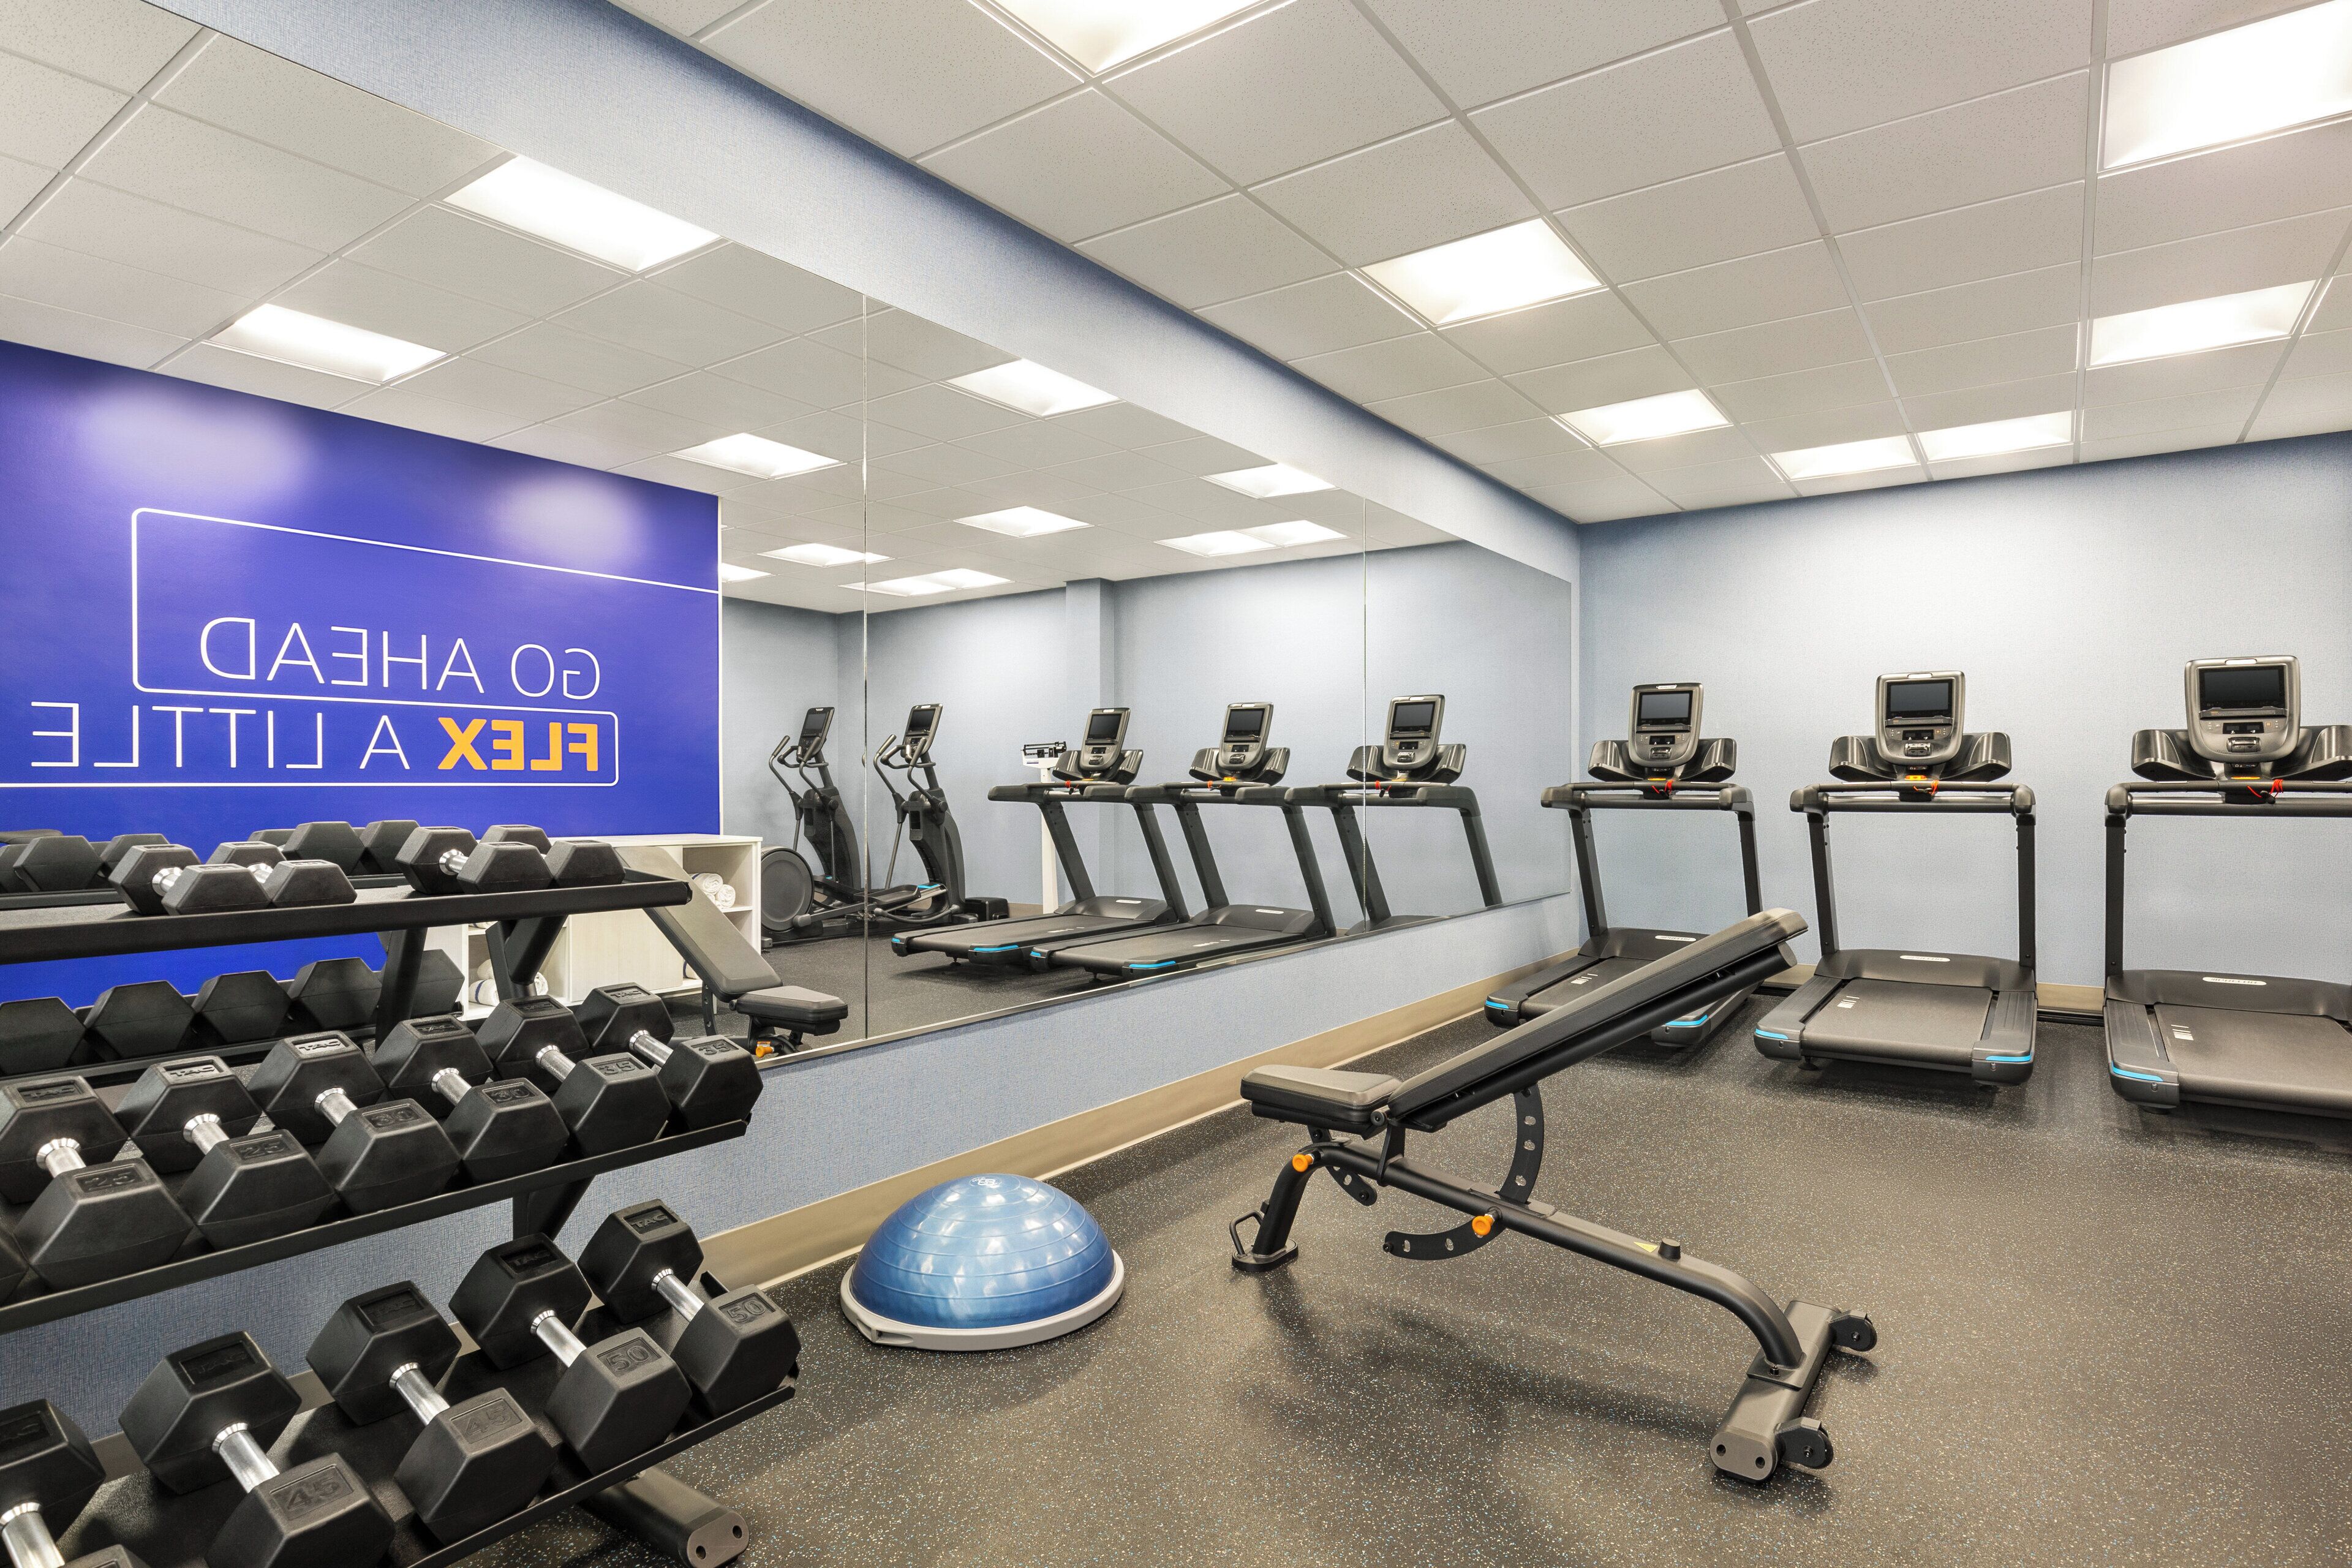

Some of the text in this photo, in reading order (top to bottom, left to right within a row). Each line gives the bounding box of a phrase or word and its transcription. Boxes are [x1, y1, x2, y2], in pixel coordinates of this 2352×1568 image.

[698, 1042, 731, 1055] 35
[598, 1061, 636, 1075] 35
[491, 1088, 530, 1102] 30
[371, 1109, 415, 1127] 30
[240, 1141, 285, 1159] 25
[85, 1170, 135, 1191] 25
[726, 1300, 766, 1323] 50
[606, 1345, 652, 1372] 50
[466, 1408, 512, 1436] 45
[286, 1475, 341, 1512] 45
